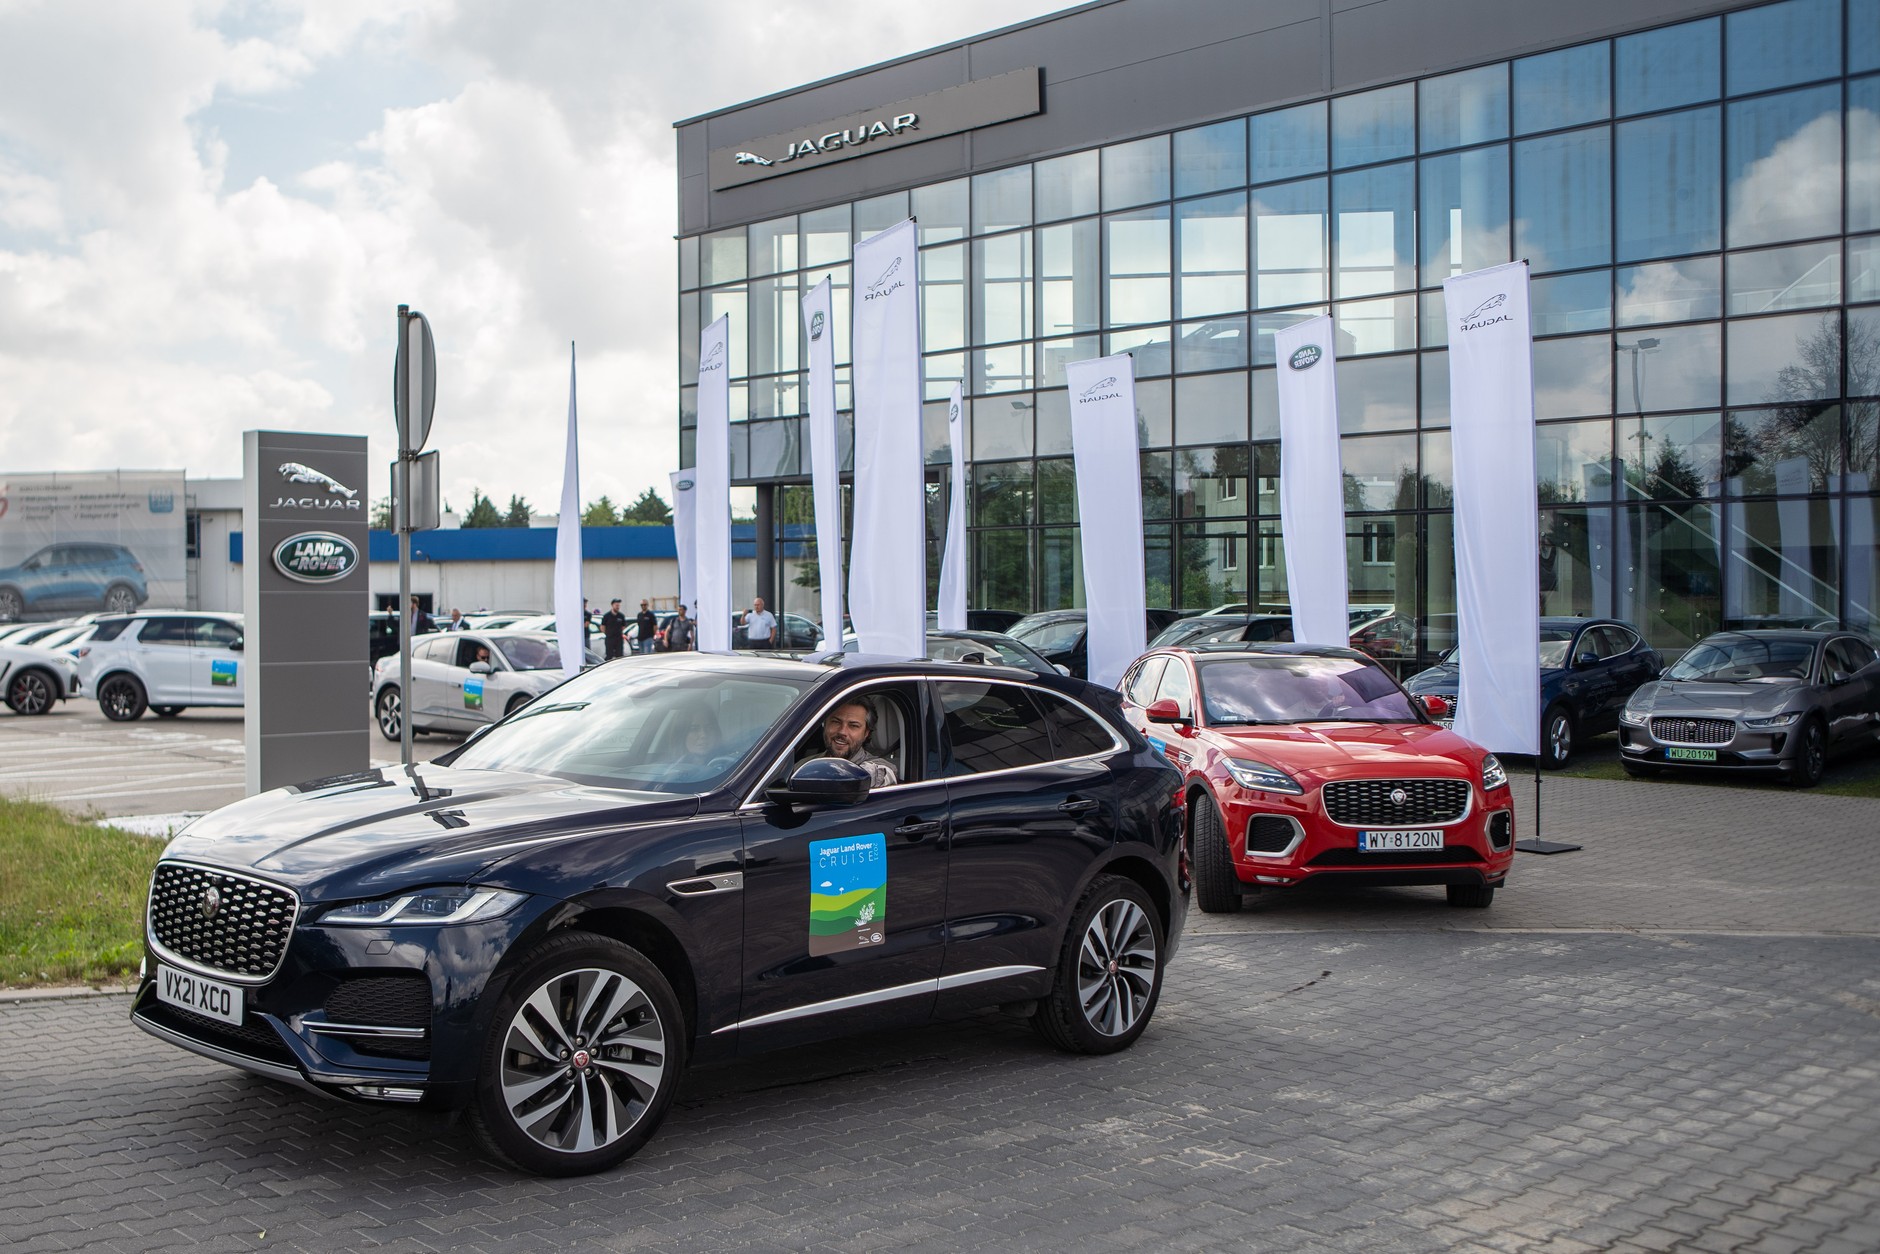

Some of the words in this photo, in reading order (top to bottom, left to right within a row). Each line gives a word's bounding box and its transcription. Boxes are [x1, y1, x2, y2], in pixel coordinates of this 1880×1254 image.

[777, 112, 919, 163] JAGUAR
[269, 497, 361, 510] JAGUAR
[294, 542, 335, 556] LAND
[297, 556, 347, 570] ROVER
[1670, 748, 1683, 758] WU
[1686, 749, 1715, 760] 2019M
[1369, 831, 1389, 848] WY
[1394, 831, 1440, 848] 8120N
[819, 847, 840, 857] Jaguar
[840, 843, 855, 853] Land
[855, 842, 873, 851] Rover
[819, 850, 874, 869] CRUISE
[165, 970, 196, 1006] VX21
[199, 982, 231, 1017] XCO
